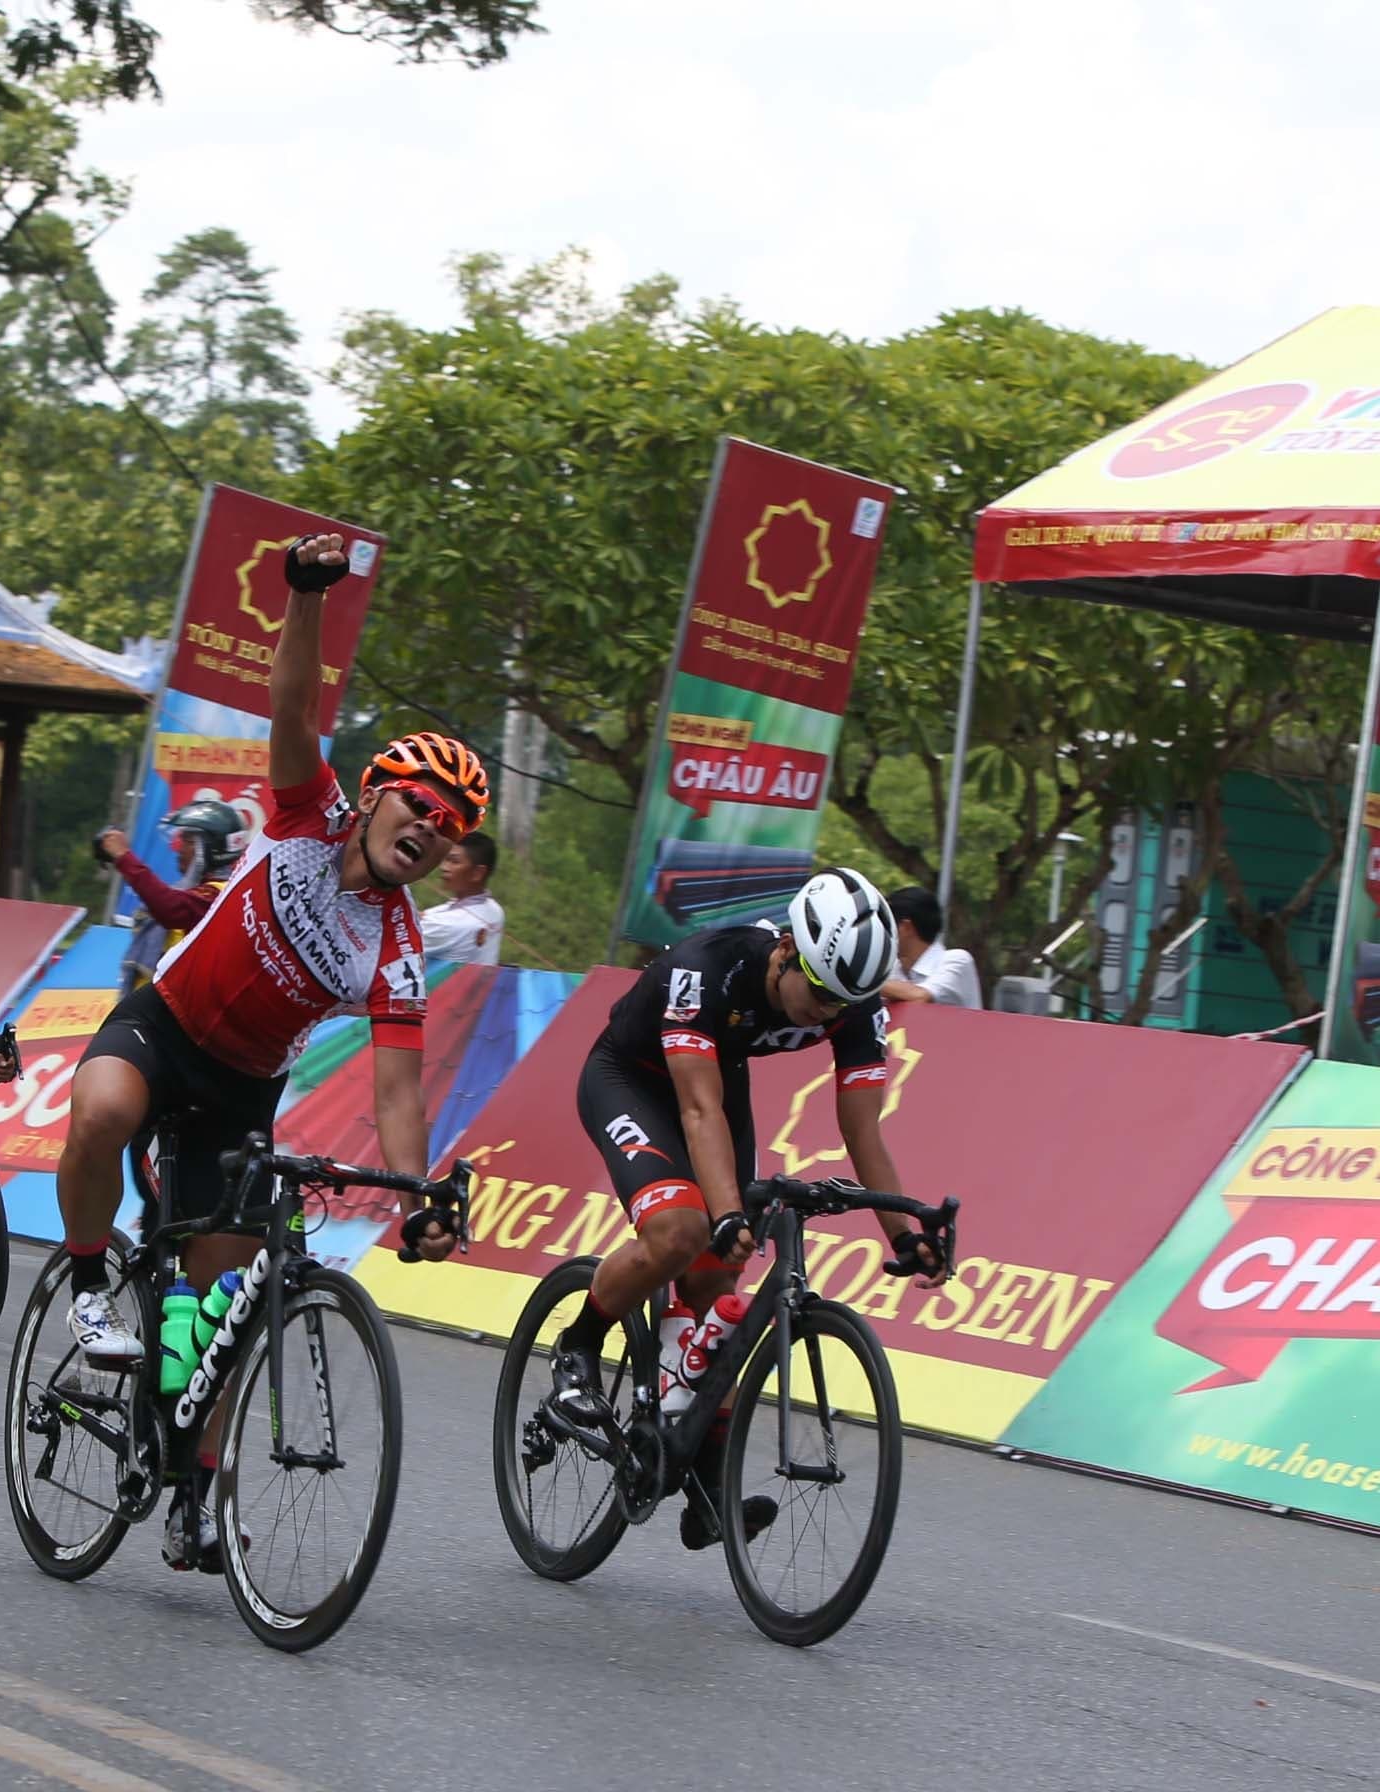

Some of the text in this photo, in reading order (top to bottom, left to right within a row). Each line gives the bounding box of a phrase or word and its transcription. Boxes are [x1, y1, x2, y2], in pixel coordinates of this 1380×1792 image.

[236, 639, 274, 667] HO
[674, 756, 819, 800] CHÂU ÂU
[817, 916, 847, 970] RUDY
[306, 940, 351, 996] MINH
[676, 971, 693, 1008] 2
[660, 1033, 715, 1050] ELT
[842, 1066, 887, 1086] FE
[1249, 1136, 1375, 1182] CÔNG
[631, 1184, 689, 1224] ELT
[911, 1256, 1115, 1352] SEN
